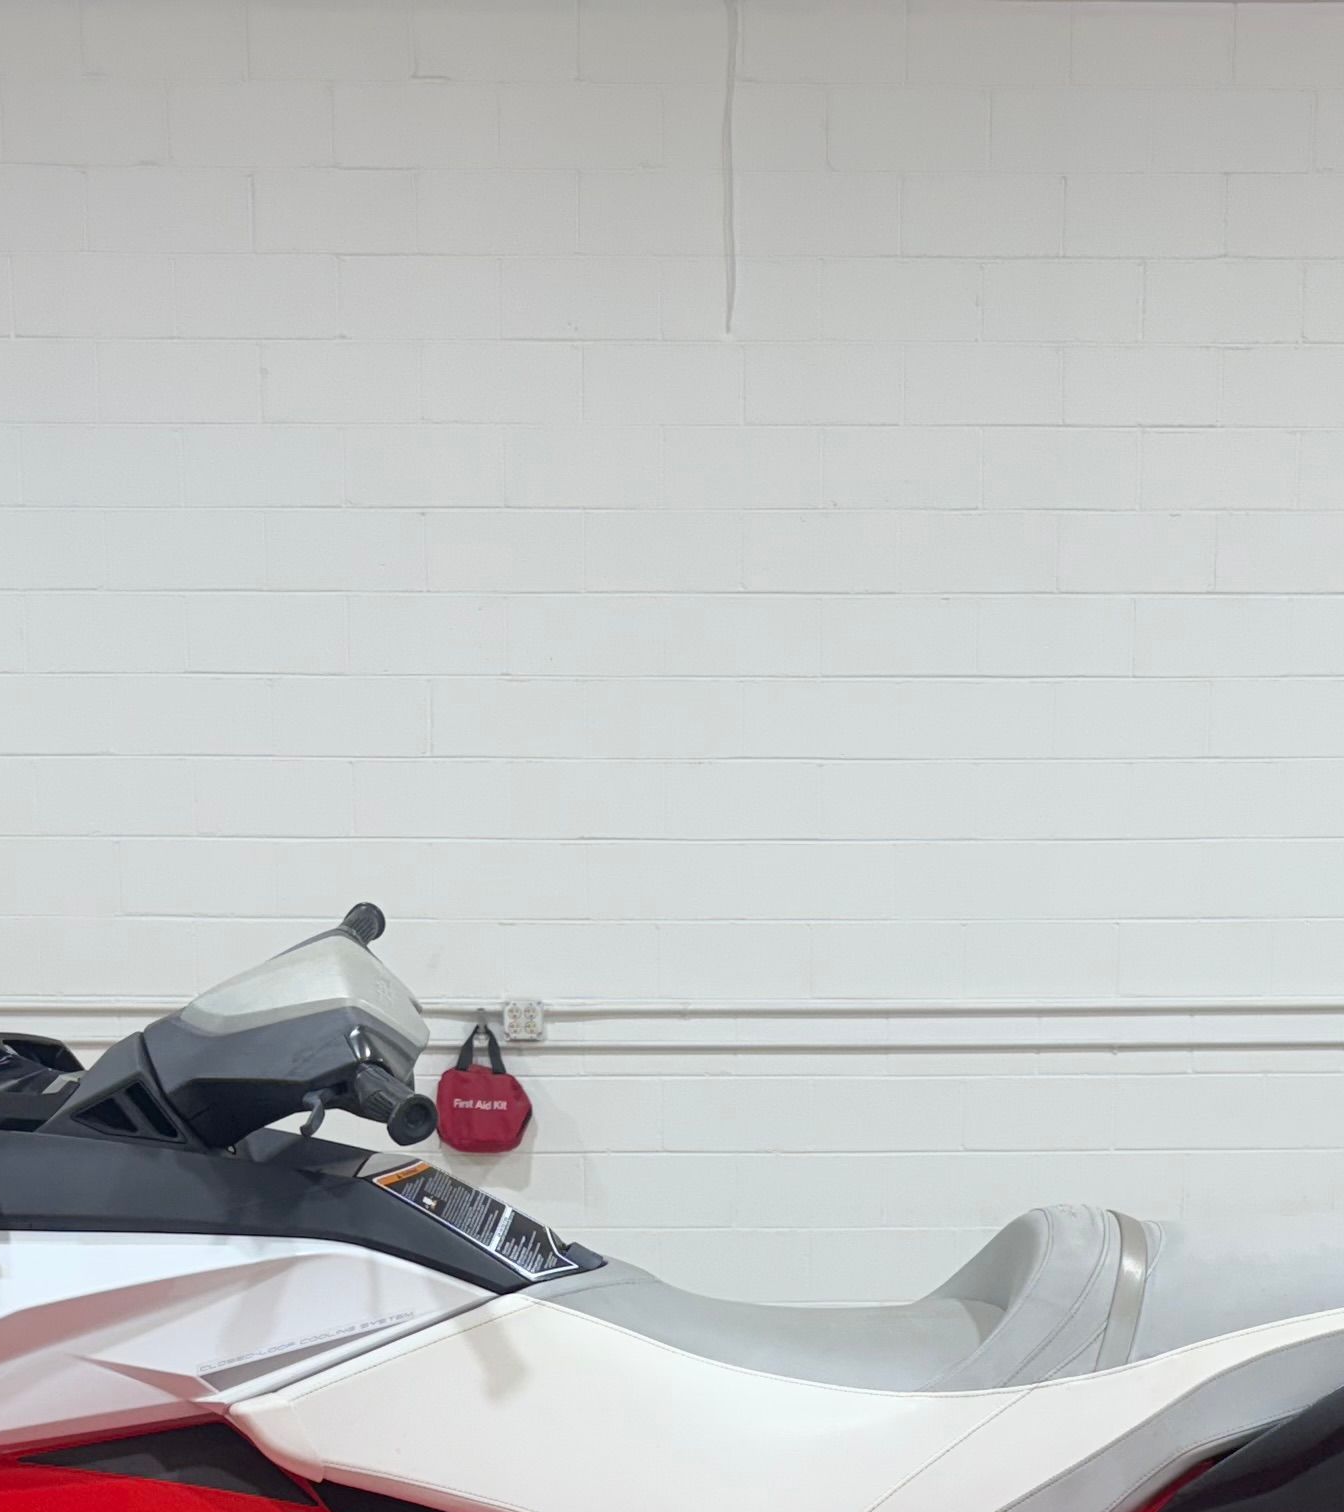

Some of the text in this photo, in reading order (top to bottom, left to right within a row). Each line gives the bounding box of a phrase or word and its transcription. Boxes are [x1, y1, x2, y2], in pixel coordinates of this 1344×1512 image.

[453, 1098, 507, 1110] First Aid Kit
